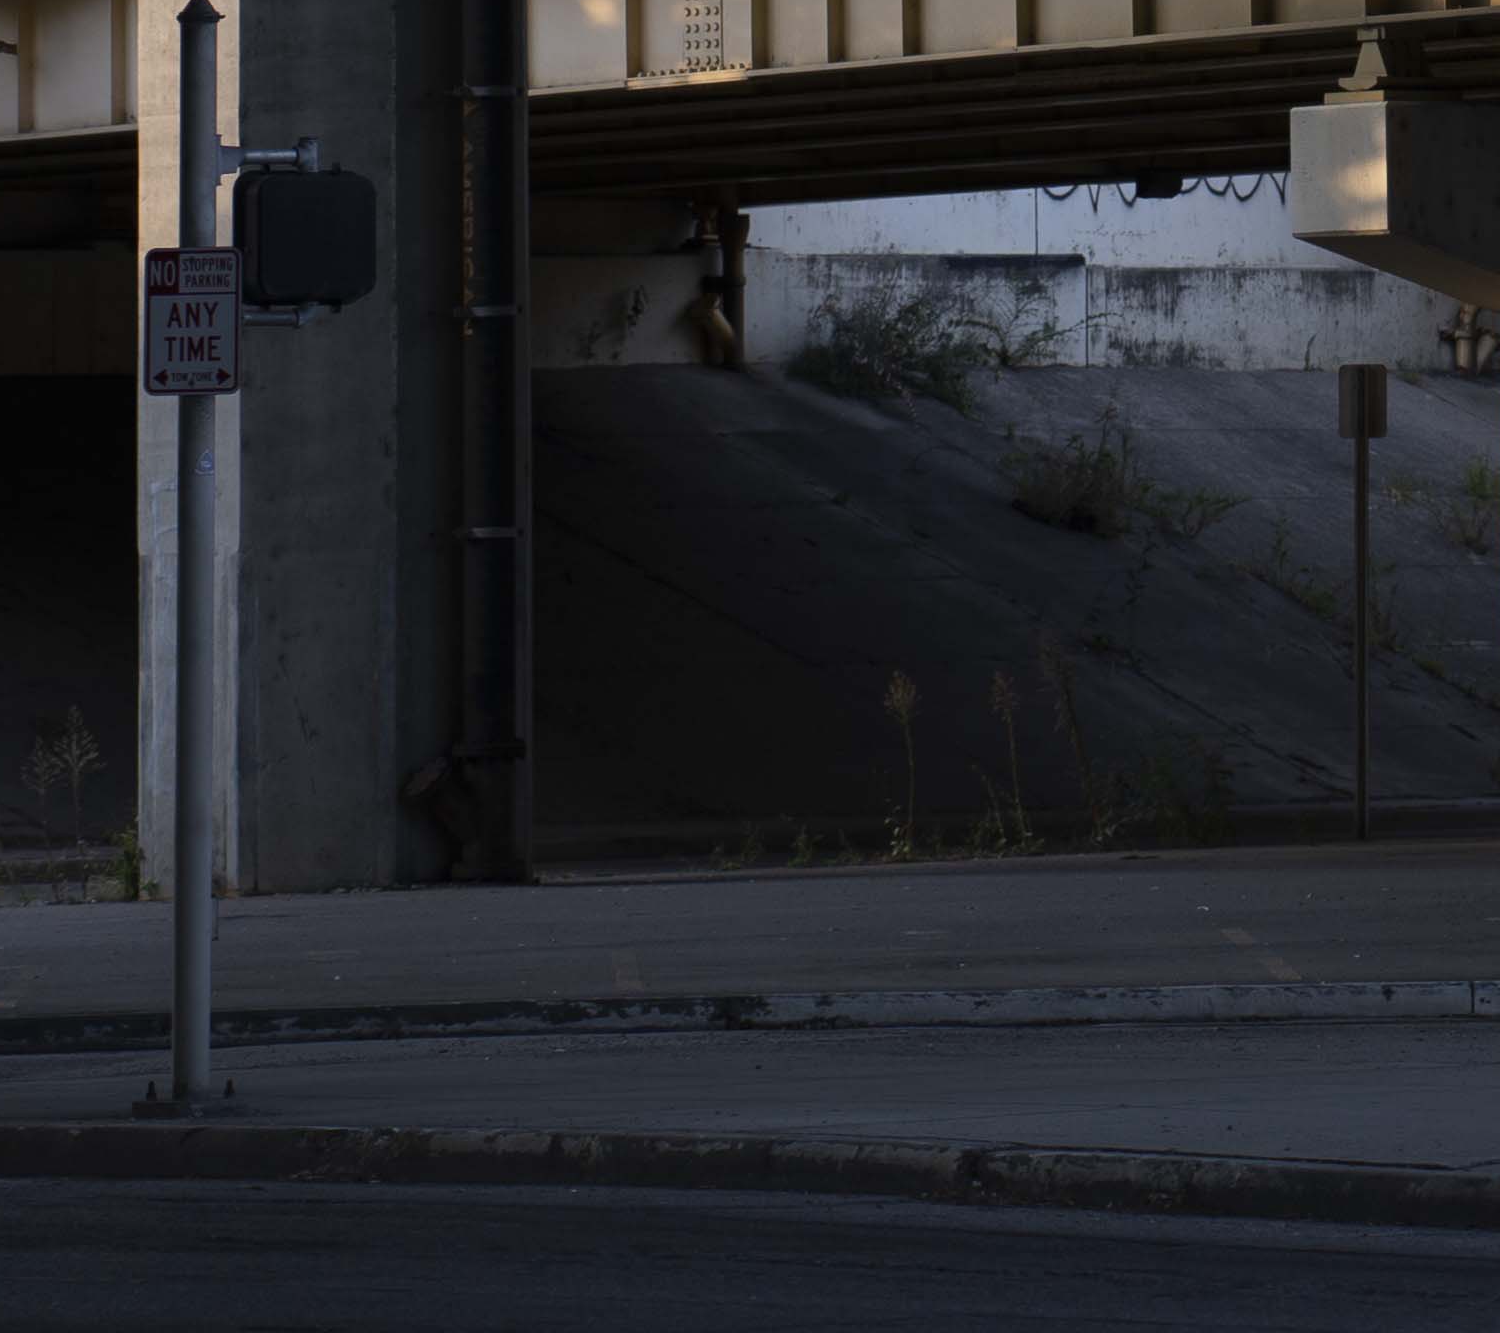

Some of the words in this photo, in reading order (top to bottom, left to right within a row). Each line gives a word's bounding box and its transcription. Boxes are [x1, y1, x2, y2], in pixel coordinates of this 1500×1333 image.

[151, 261, 177, 286] NO
[182, 257, 233, 271] STOPPING
[185, 274, 230, 288] PARKING
[167, 302, 218, 328] ANY
[164, 336, 221, 362] TIME
